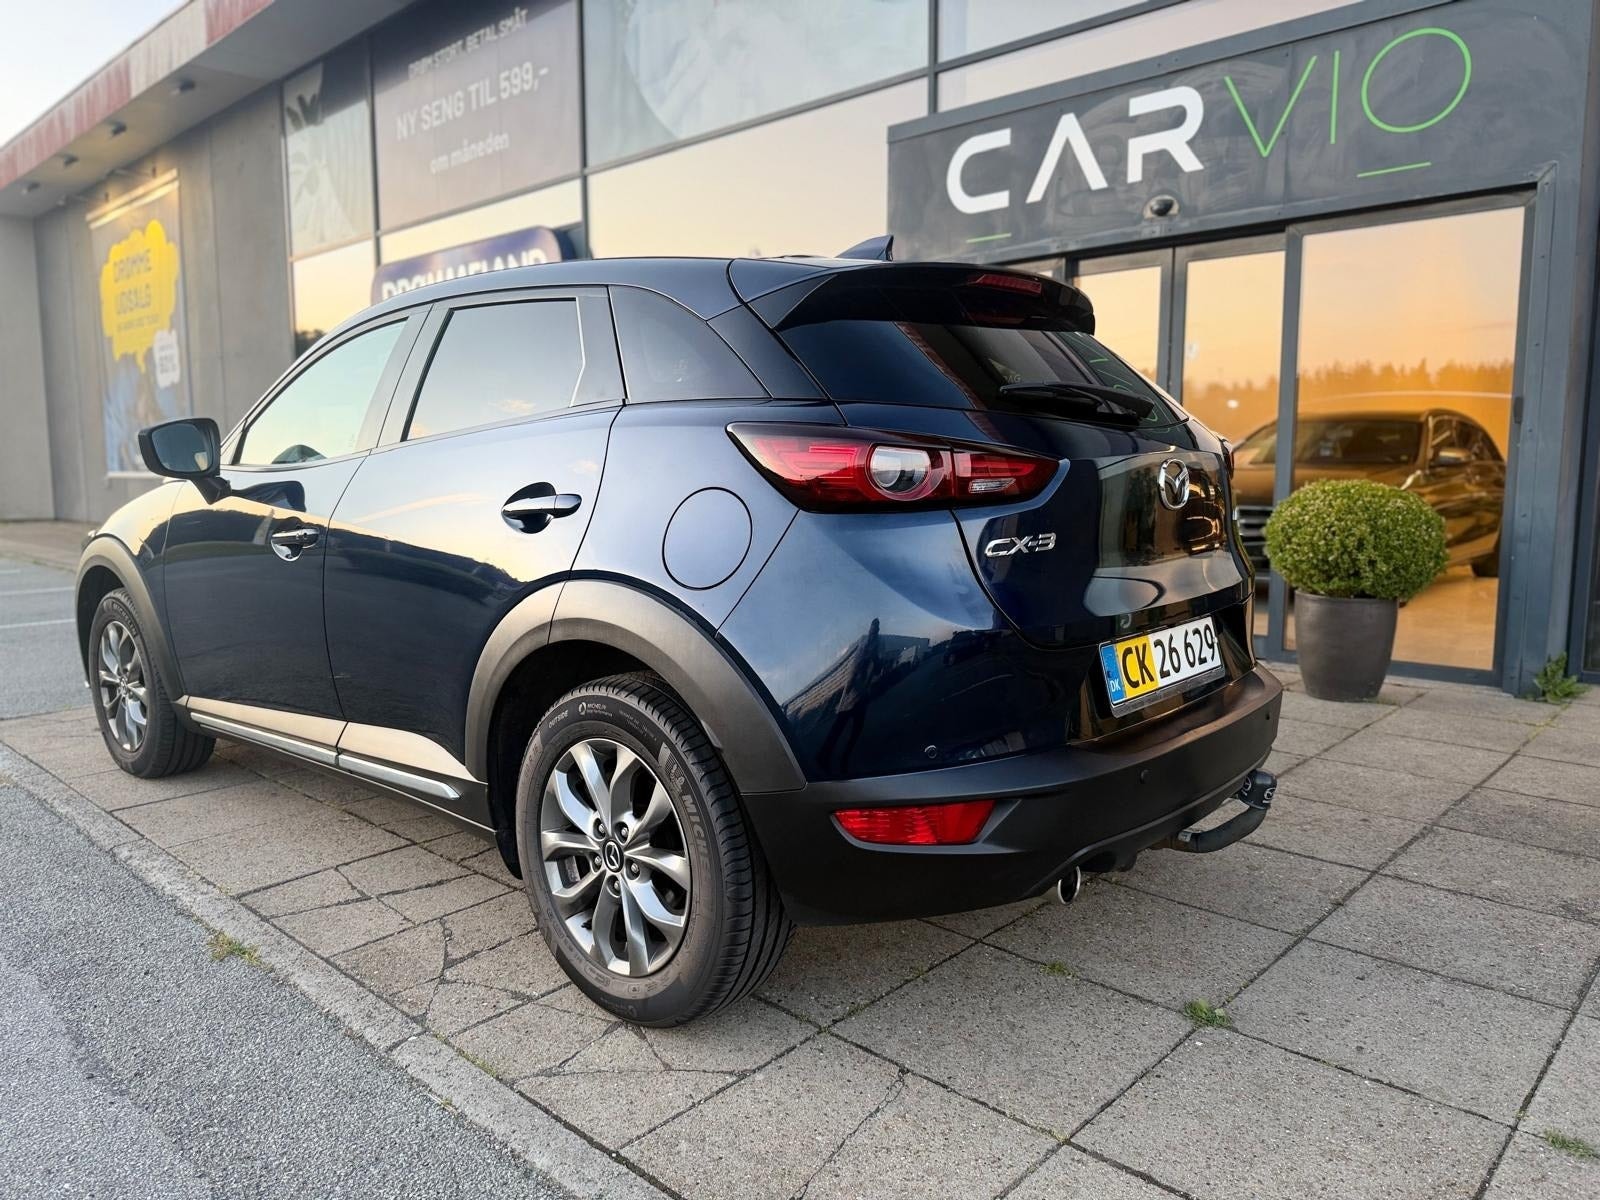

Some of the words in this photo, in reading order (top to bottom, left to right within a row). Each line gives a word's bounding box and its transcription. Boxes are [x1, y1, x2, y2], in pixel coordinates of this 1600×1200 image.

[396, 108, 421, 141] NY
[420, 91, 465, 131] SENG
[467, 76, 497, 111] TIL
[500, 61, 550, 100] 599,-
[946, 27, 1473, 214] CARVIO
[429, 157, 449, 174] om
[449, 131, 510, 167] måneden
[984, 532, 1057, 558] CX-3
[1121, 641, 1156, 689] CK
[1154, 633, 1182, 679] 26
[1183, 623, 1216, 669] 629
[1109, 678, 1122, 694] DK
[548, 709, 569, 729] OUTSIDE
